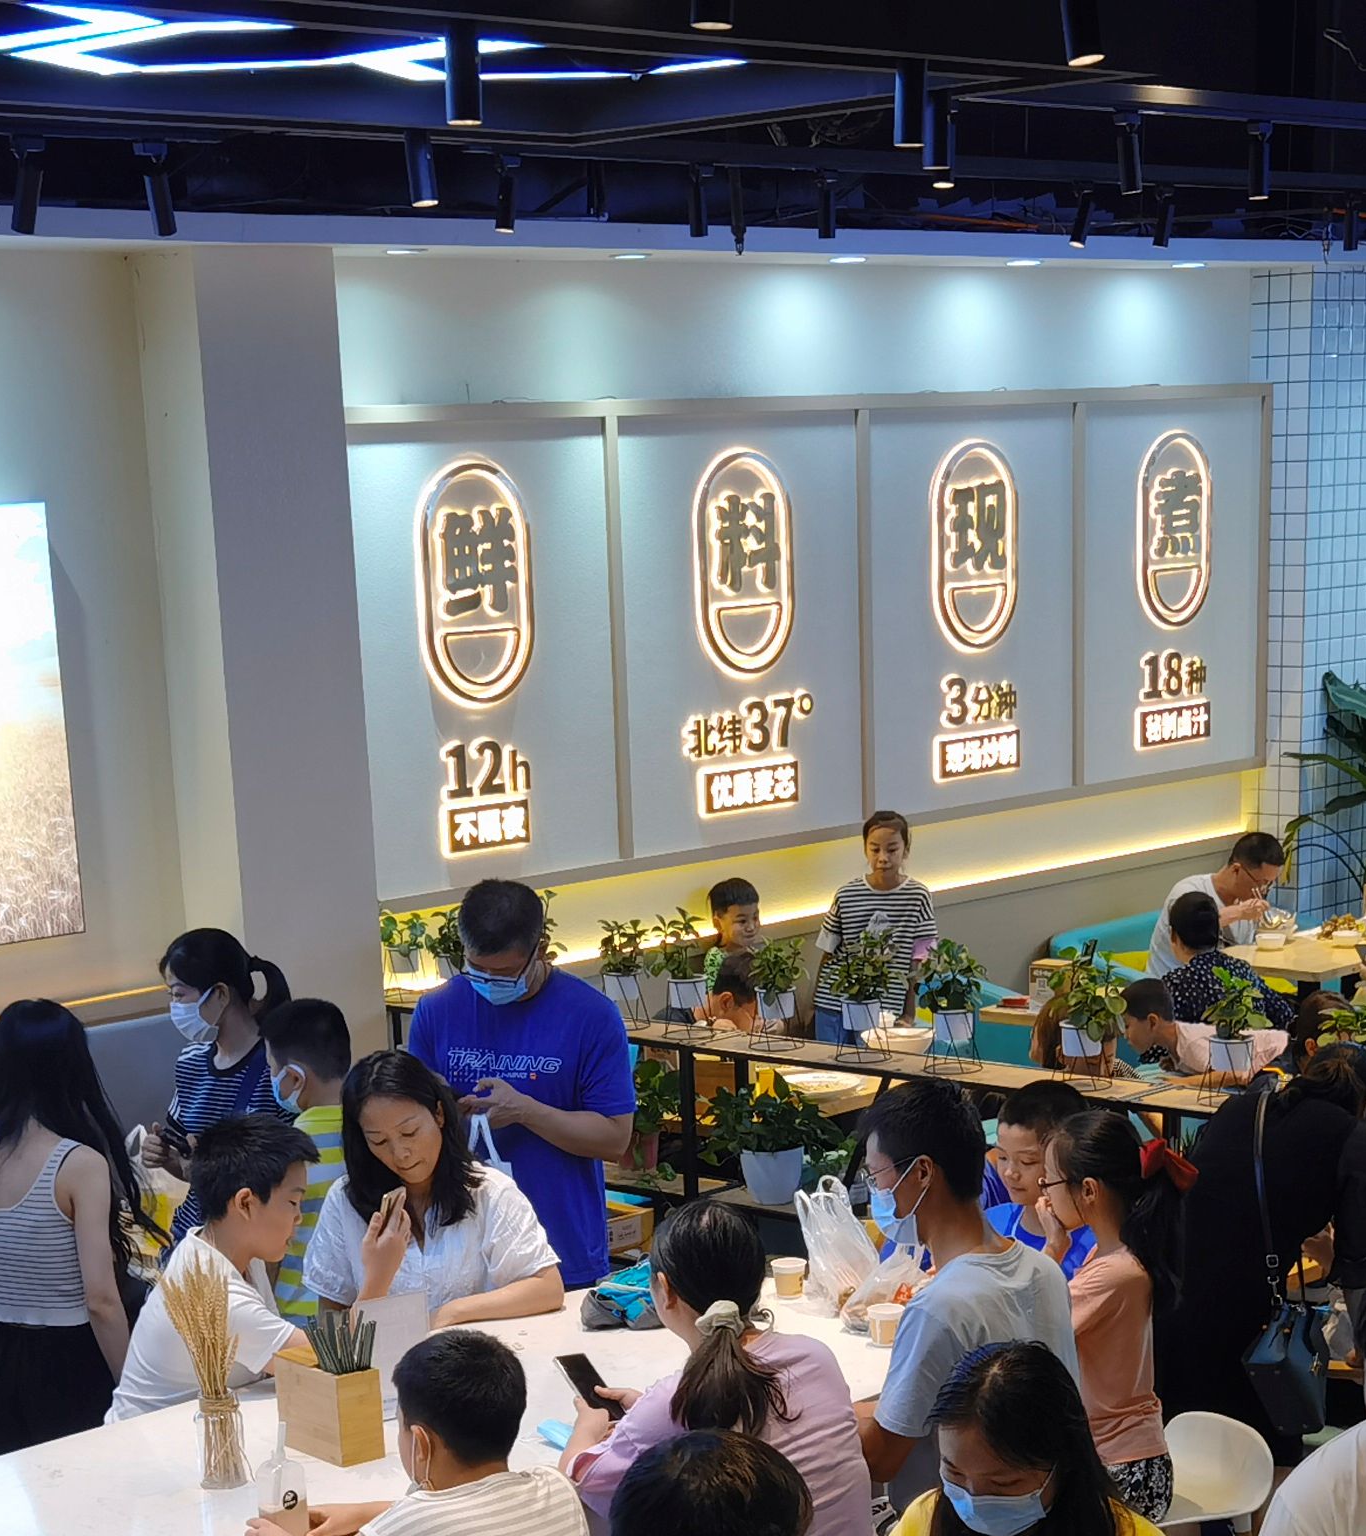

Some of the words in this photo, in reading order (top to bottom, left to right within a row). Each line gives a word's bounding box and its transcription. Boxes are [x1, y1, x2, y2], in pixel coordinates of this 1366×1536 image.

[714, 492, 782, 595] 料
[948, 479, 1006, 573] 现
[1154, 469, 1202, 559] 煮
[440, 505, 517, 619] 鲜
[443, 740, 531, 800] 12h
[447, 1049, 563, 1074] TRAINING
